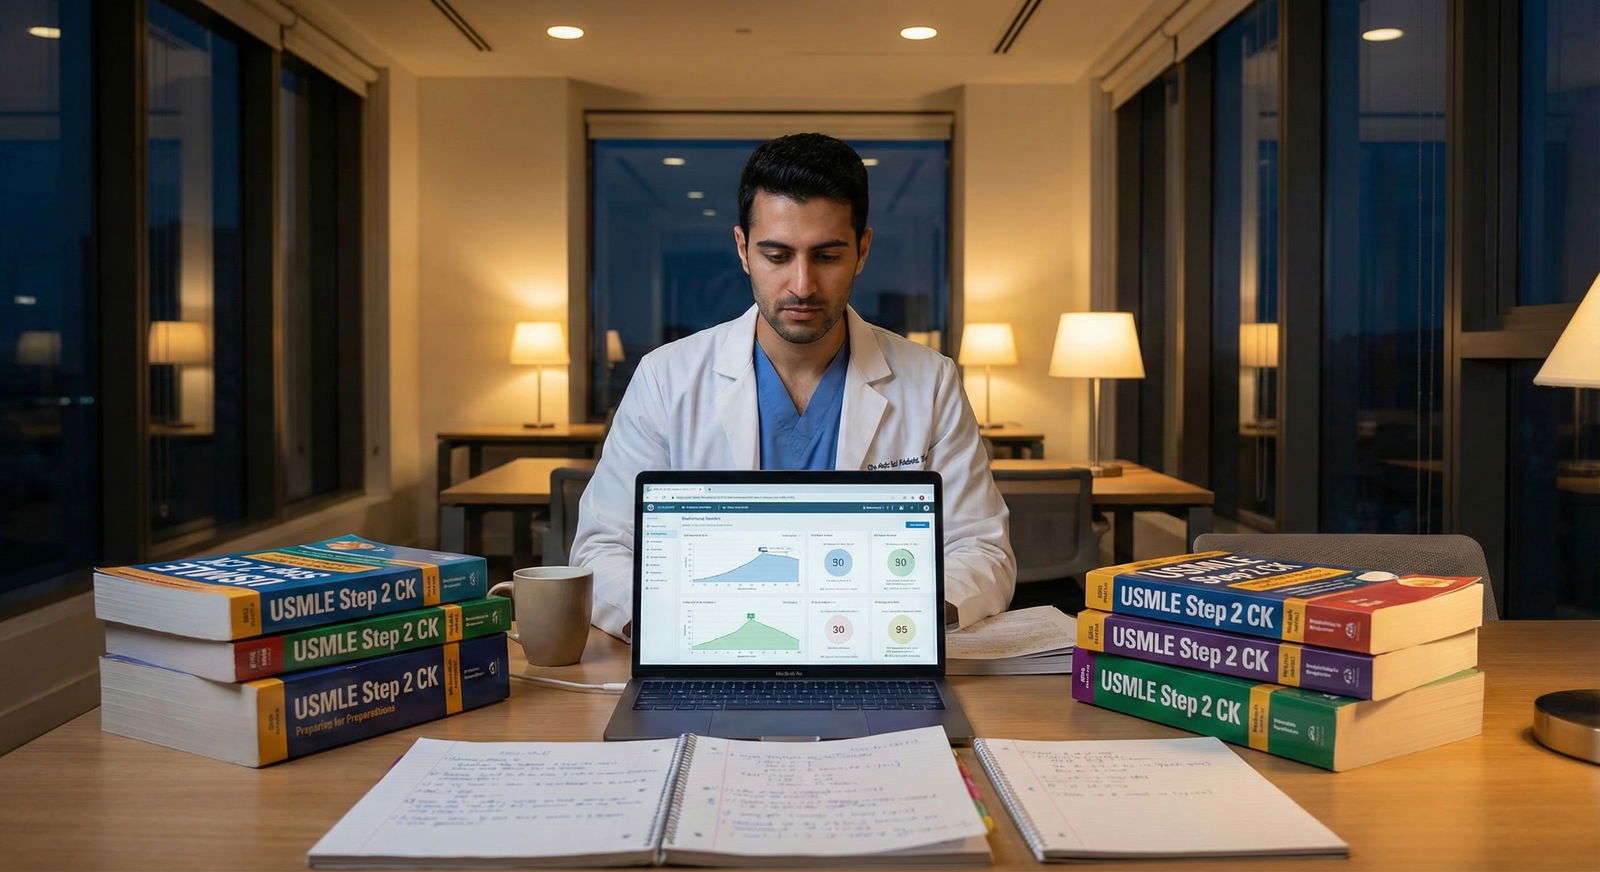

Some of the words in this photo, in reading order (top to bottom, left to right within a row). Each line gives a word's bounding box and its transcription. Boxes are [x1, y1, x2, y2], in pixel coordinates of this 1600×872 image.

[149, 562, 287, 587] USMLE
[1136, 555, 1266, 579] USMLE
[1256, 562, 1303, 572] CK
[270, 590, 335, 622] USMLE
[339, 588, 377, 611] Step
[381, 582, 391, 603] 2
[395, 577, 417, 600] CK
[1121, 585, 1182, 614] USMLE
[1185, 594, 1227, 627] Step
[1230, 602, 1242, 624] 2
[1247, 603, 1274, 629] CK
[293, 631, 357, 662] USMLE
[362, 628, 399, 650] Step
[403, 622, 413, 643] 2
[417, 617, 439, 640] CK
[832, 625, 845, 634] 30
[895, 625, 908, 634] 95
[1112, 626, 1175, 656] USMLE
[1180, 637, 1221, 669] Step
[1225, 645, 1237, 667] 2
[1242, 647, 1270, 673] CK
[294, 684, 358, 720] USMLE
[362, 680, 400, 702] Step
[403, 671, 413, 694] 2
[417, 665, 439, 690] CK
[1101, 669, 1157, 703] USMLE
[1160, 684, 1197, 718] Step
[1201, 695, 1212, 717] 2
[1216, 698, 1241, 725] CK
